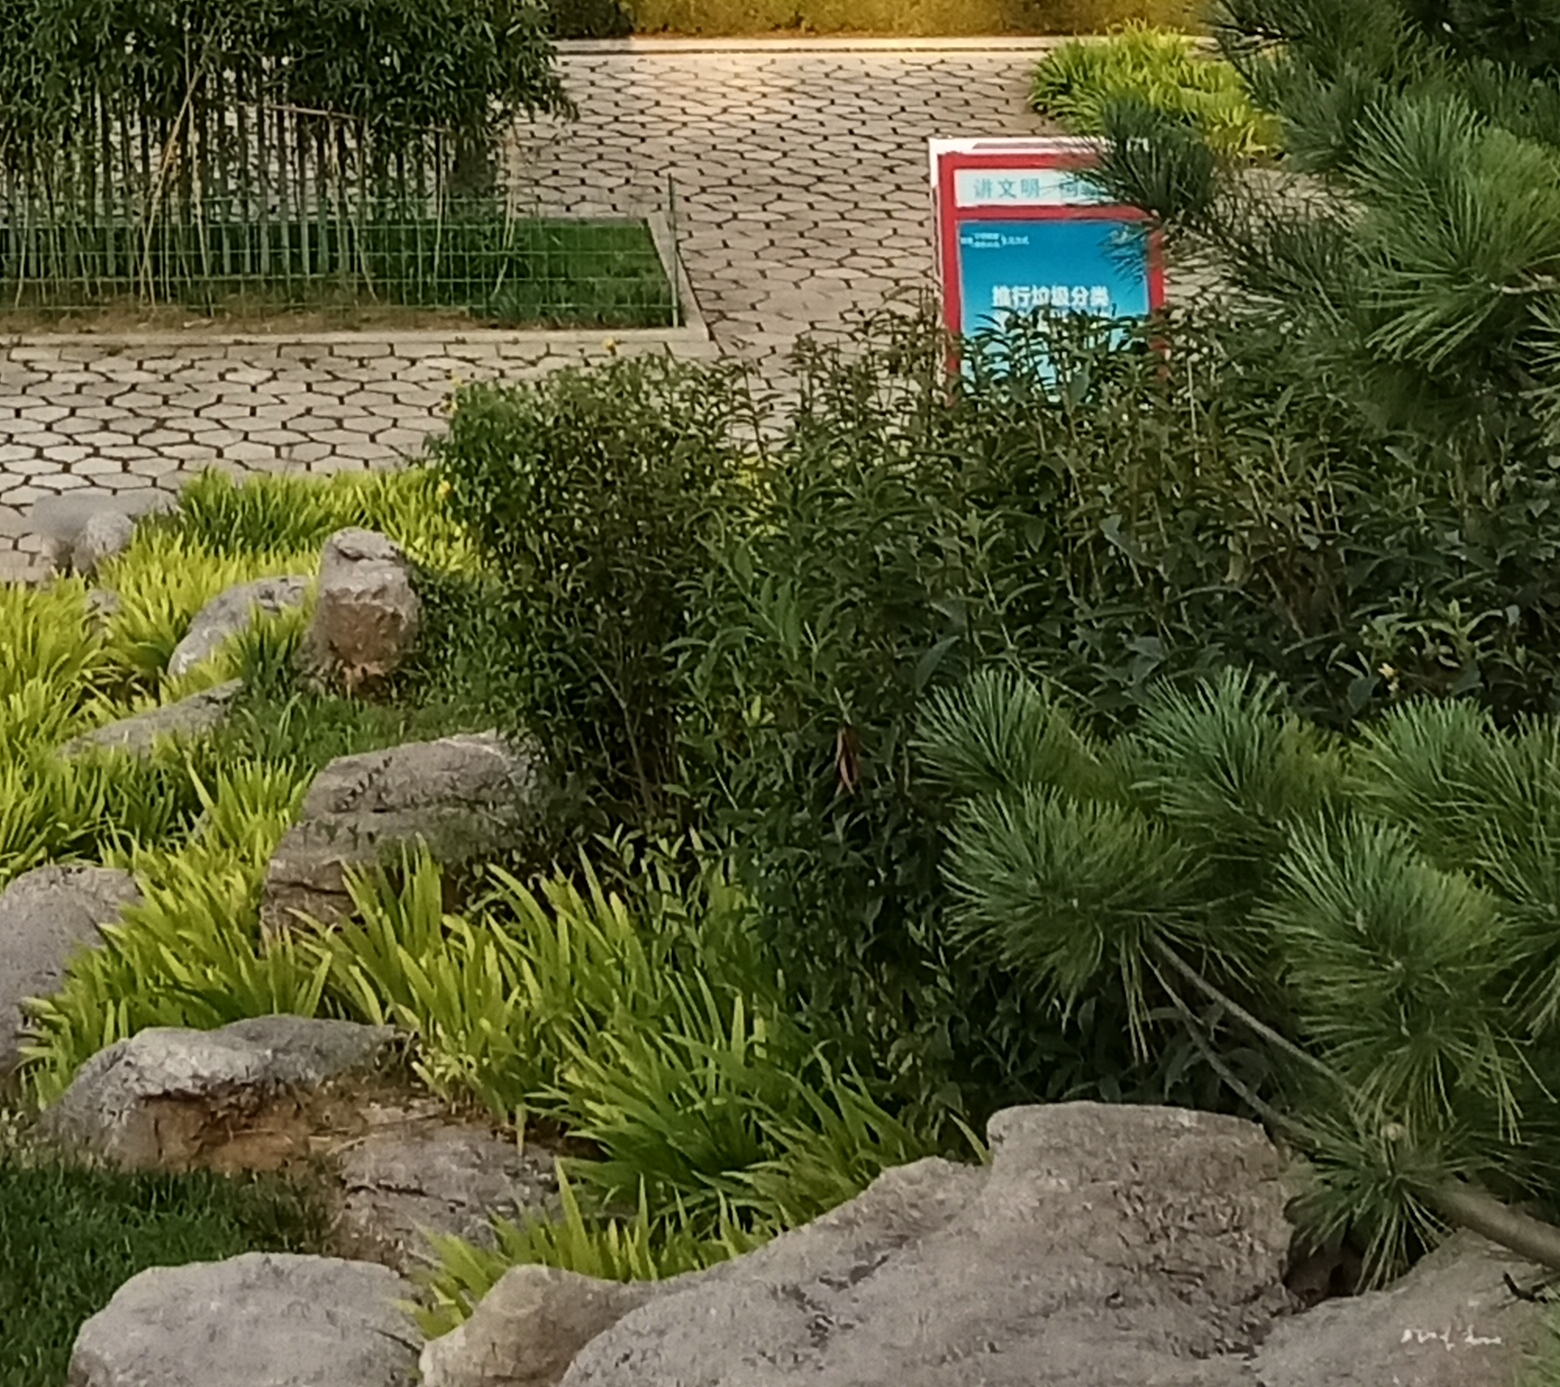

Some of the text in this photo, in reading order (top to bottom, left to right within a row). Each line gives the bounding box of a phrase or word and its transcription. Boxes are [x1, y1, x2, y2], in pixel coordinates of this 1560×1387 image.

[992, 283, 1112, 308] 推行垃圾分类
